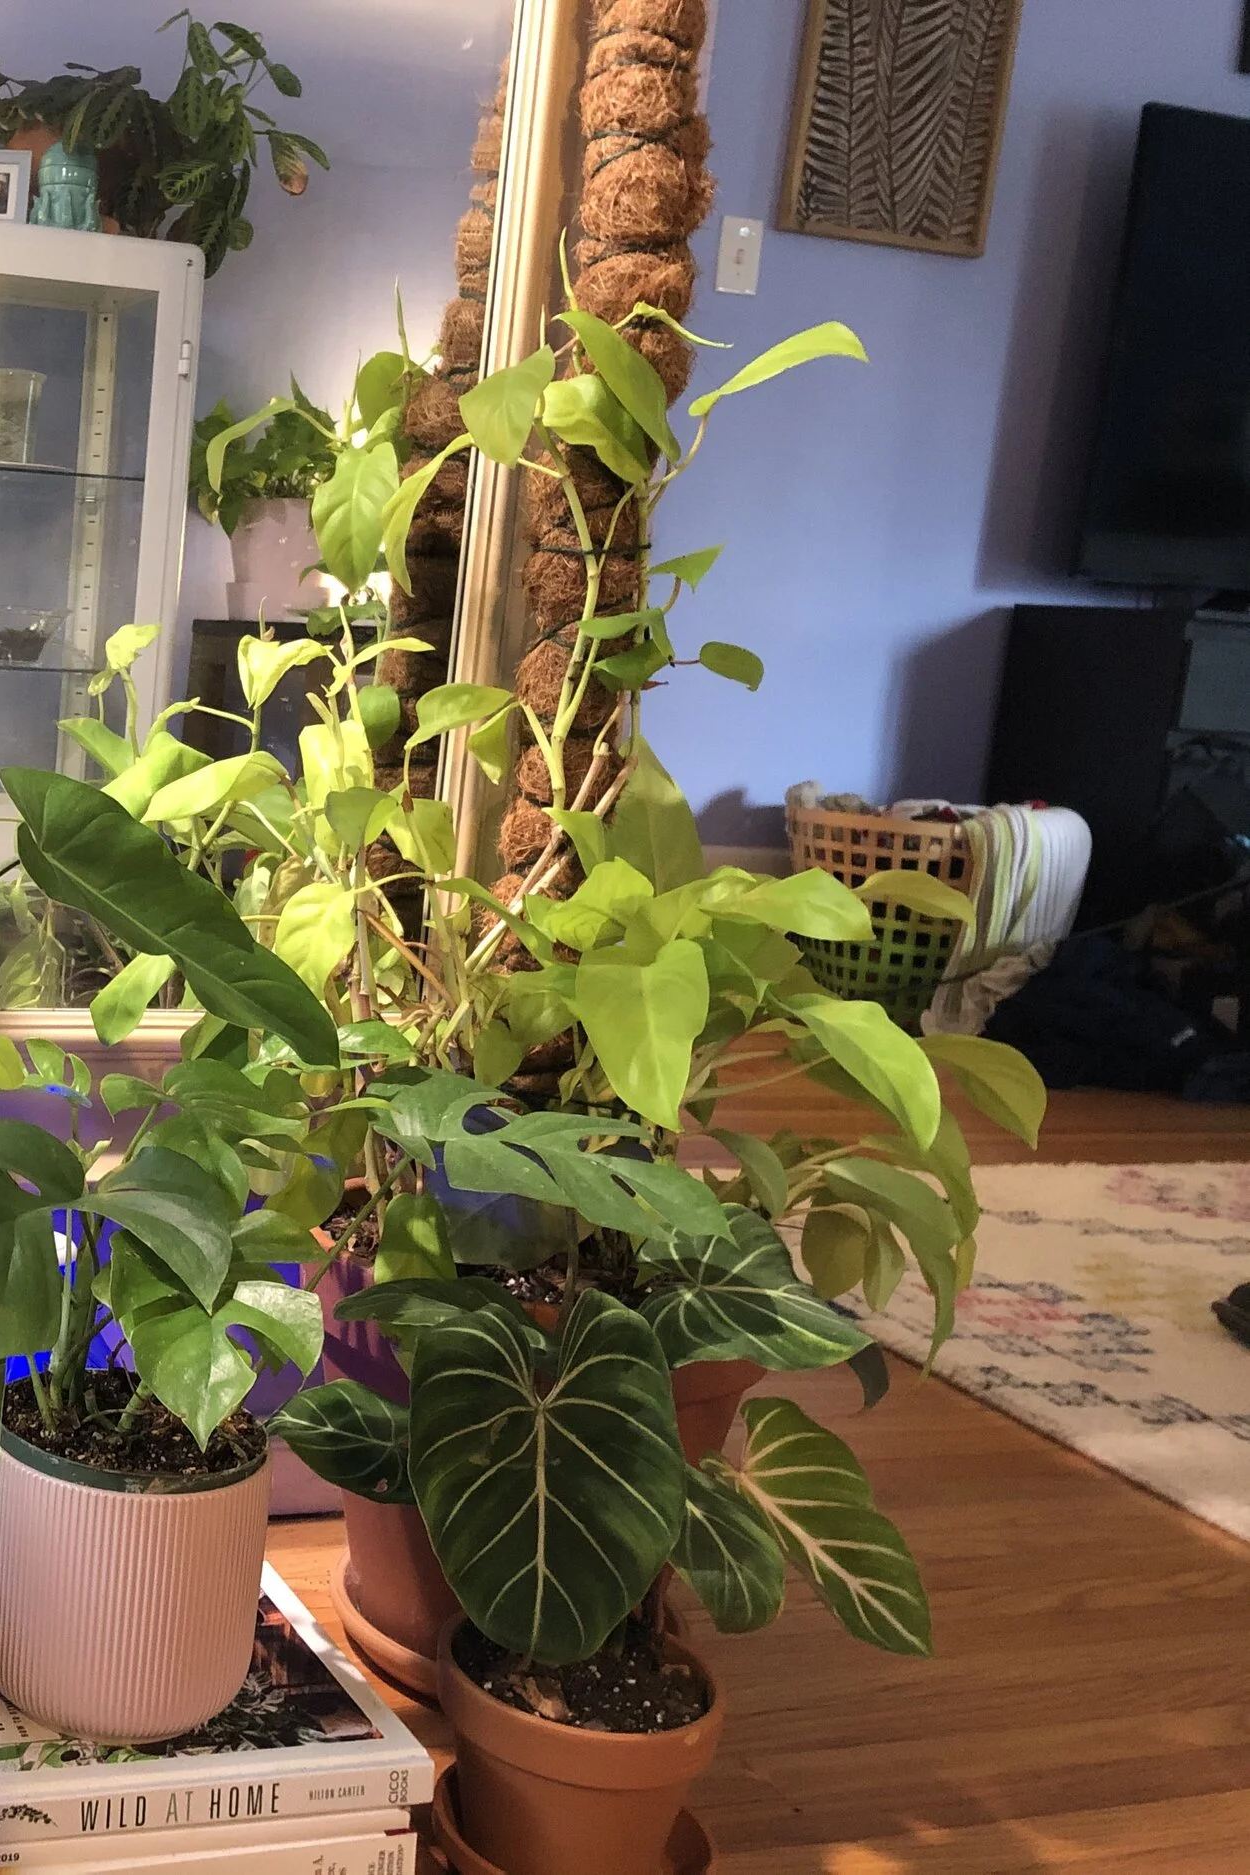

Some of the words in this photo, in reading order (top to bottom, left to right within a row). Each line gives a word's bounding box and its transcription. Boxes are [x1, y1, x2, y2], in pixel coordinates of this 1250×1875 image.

[388, 1770, 400, 1804] CICO
[400, 1769, 409, 1803] BOOKS
[81, 1796, 147, 1831] WILD
[166, 1791, 194, 1823] AT
[210, 1783, 280, 1819] HOME
[309, 1788, 335, 1801] HILTON
[338, 1785, 365, 1798] CARTER
